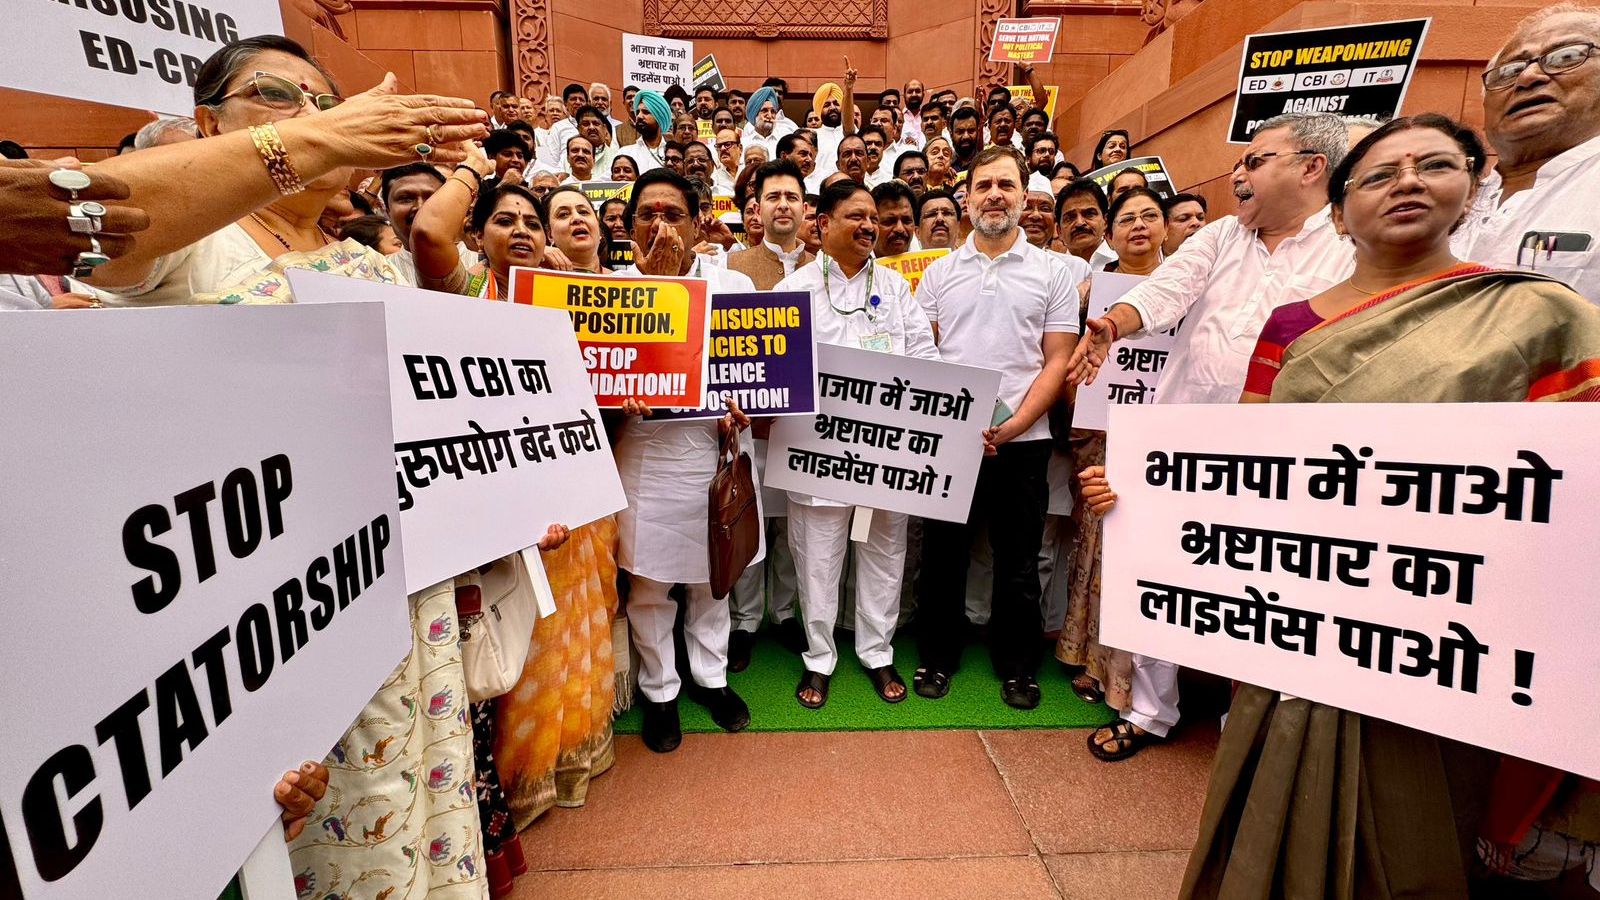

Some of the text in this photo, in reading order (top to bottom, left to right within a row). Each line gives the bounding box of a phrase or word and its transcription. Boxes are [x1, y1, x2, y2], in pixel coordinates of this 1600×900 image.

[47, 0, 238, 46] SUSING
[79, 30, 203, 88] ED-CB
[630, 44, 686, 59] भाजपा में जाओ
[669, 63, 679, 72] का
[1250, 39, 1412, 69] STOP WEAPONIZING
[1249, 72, 1377, 91] ED CBI IT
[1282, 95, 1349, 114] AGAINST
[712, 200, 732, 211] EIGN
[567, 285, 657, 308] RESPECT
[583, 346, 637, 370] STOP
[762, 334, 787, 355] TO
[403, 354, 552, 400] ED CBI का
[589, 373, 687, 396] IDATION!!
[708, 362, 766, 384] LENCE
[818, 372, 974, 421] ाजपा में जाओ
[514, 416, 556, 463] बंद
[553, 409, 601, 457] करो
[814, 413, 943, 457] भ्रष्टाचार का
[788, 447, 952, 498] लाइसेंस पाओ !
[1145, 444, 1563, 523] भाजपा में जाओ
[122, 453, 293, 614] STOP
[1181, 520, 1484, 605] भ्रष्टाचार का
[1137, 579, 1535, 707] लाइसेंस पाओ !
[0, 513, 391, 900] CTATORSHIP
